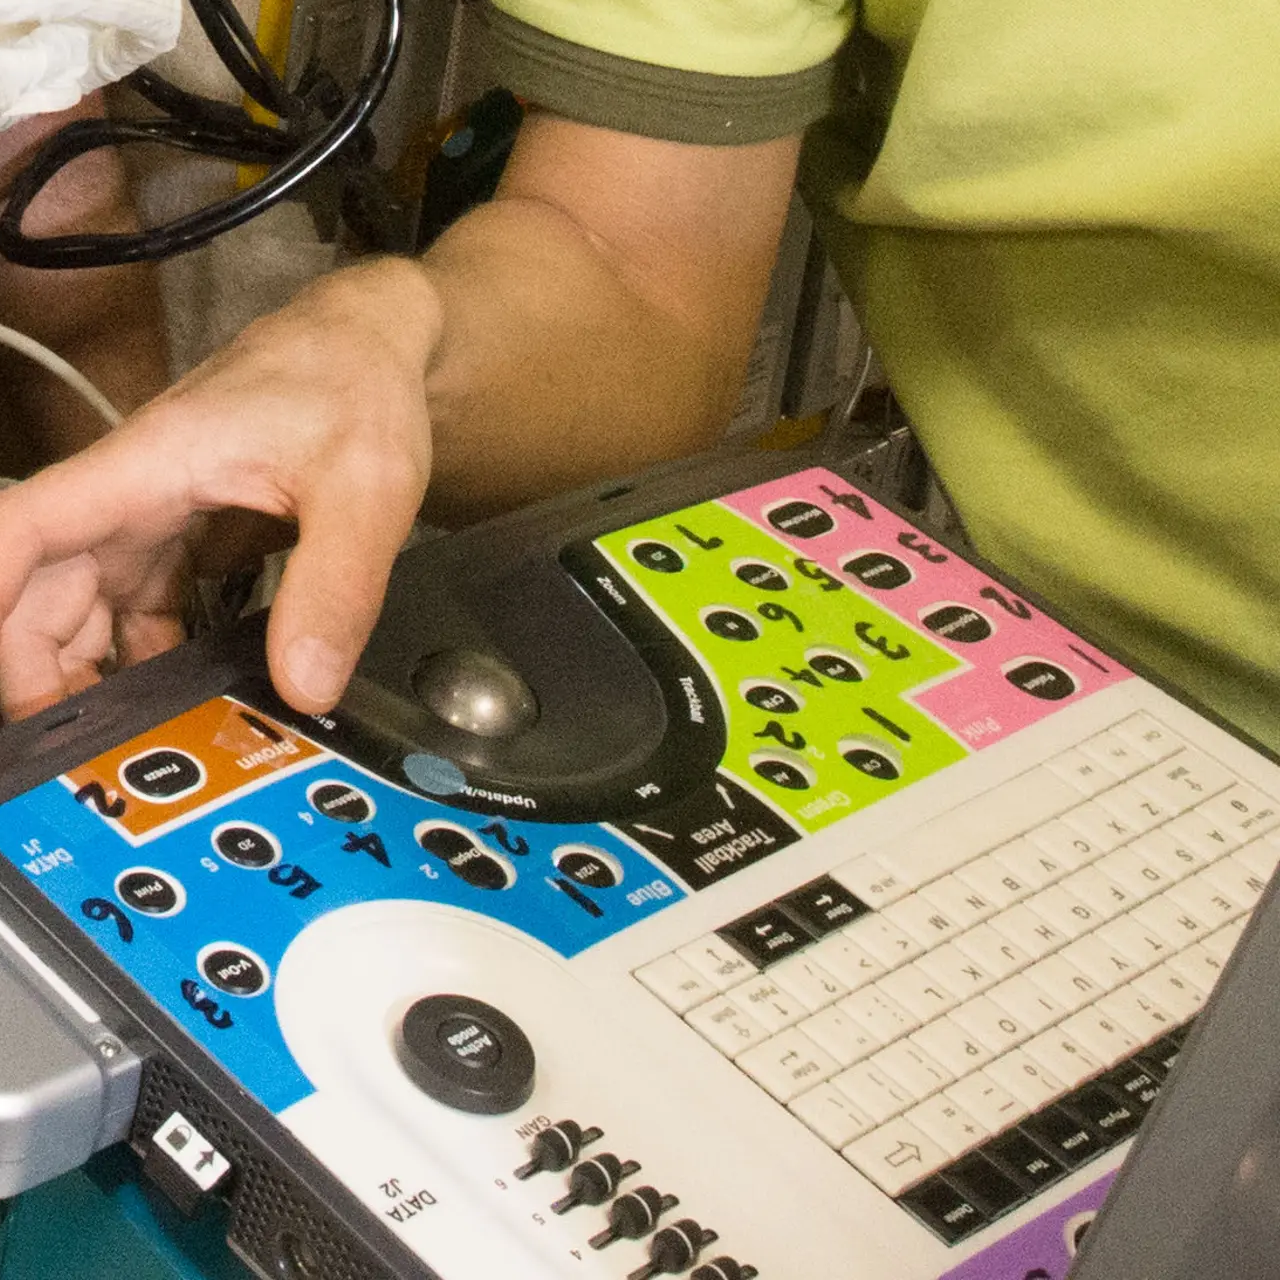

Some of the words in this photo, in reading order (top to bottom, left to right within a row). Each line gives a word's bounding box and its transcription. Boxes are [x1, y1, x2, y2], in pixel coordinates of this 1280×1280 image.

[818, 484, 874, 521] 4
[897, 532, 948, 565] 3
[793, 558, 845, 592] 5
[596, 575, 627, 606] Zoom
[757, 602, 804, 633] 6
[854, 621, 912, 661] 3
[780, 666, 824, 689] 4
[678, 676, 705, 724] Trackball
[753, 721, 807, 751] 2
[961, 716, 1001, 740] Pink
[235, 739, 299, 771] Brown
[143, 762, 180, 782] Freeze
[74, 782, 126, 819] 2
[798, 790, 852, 819] Green
[477, 823, 530, 857] 2
[690, 818, 736, 844] Area
[20, 838, 41, 856] J1
[341, 831, 392, 868] 4
[694, 826, 776, 874] Trackball
[1072, 839, 1091, 853] C
[1175, 849, 1194, 862] S
[21, 845, 74, 876] DATA
[1141, 867, 1160, 880] D
[133, 881, 164, 898] Print
[267, 863, 323, 900] 5
[626, 880, 672, 906] Blue
[1001, 877, 1021, 891] B
[81, 897, 133, 944] 6
[1071, 905, 1091, 919] G
[217, 959, 252, 981] V-Out
[961, 965, 983, 980] K
[1072, 976, 1092, 992] U
[180, 979, 234, 1030] 3
[447, 1024, 480, 1046] mode
[456, 1033, 493, 1057] Active
[514, 1113, 552, 1140] GAIN
[378, 1176, 401, 1199] J2
[384, 1189, 439, 1224] DATA
